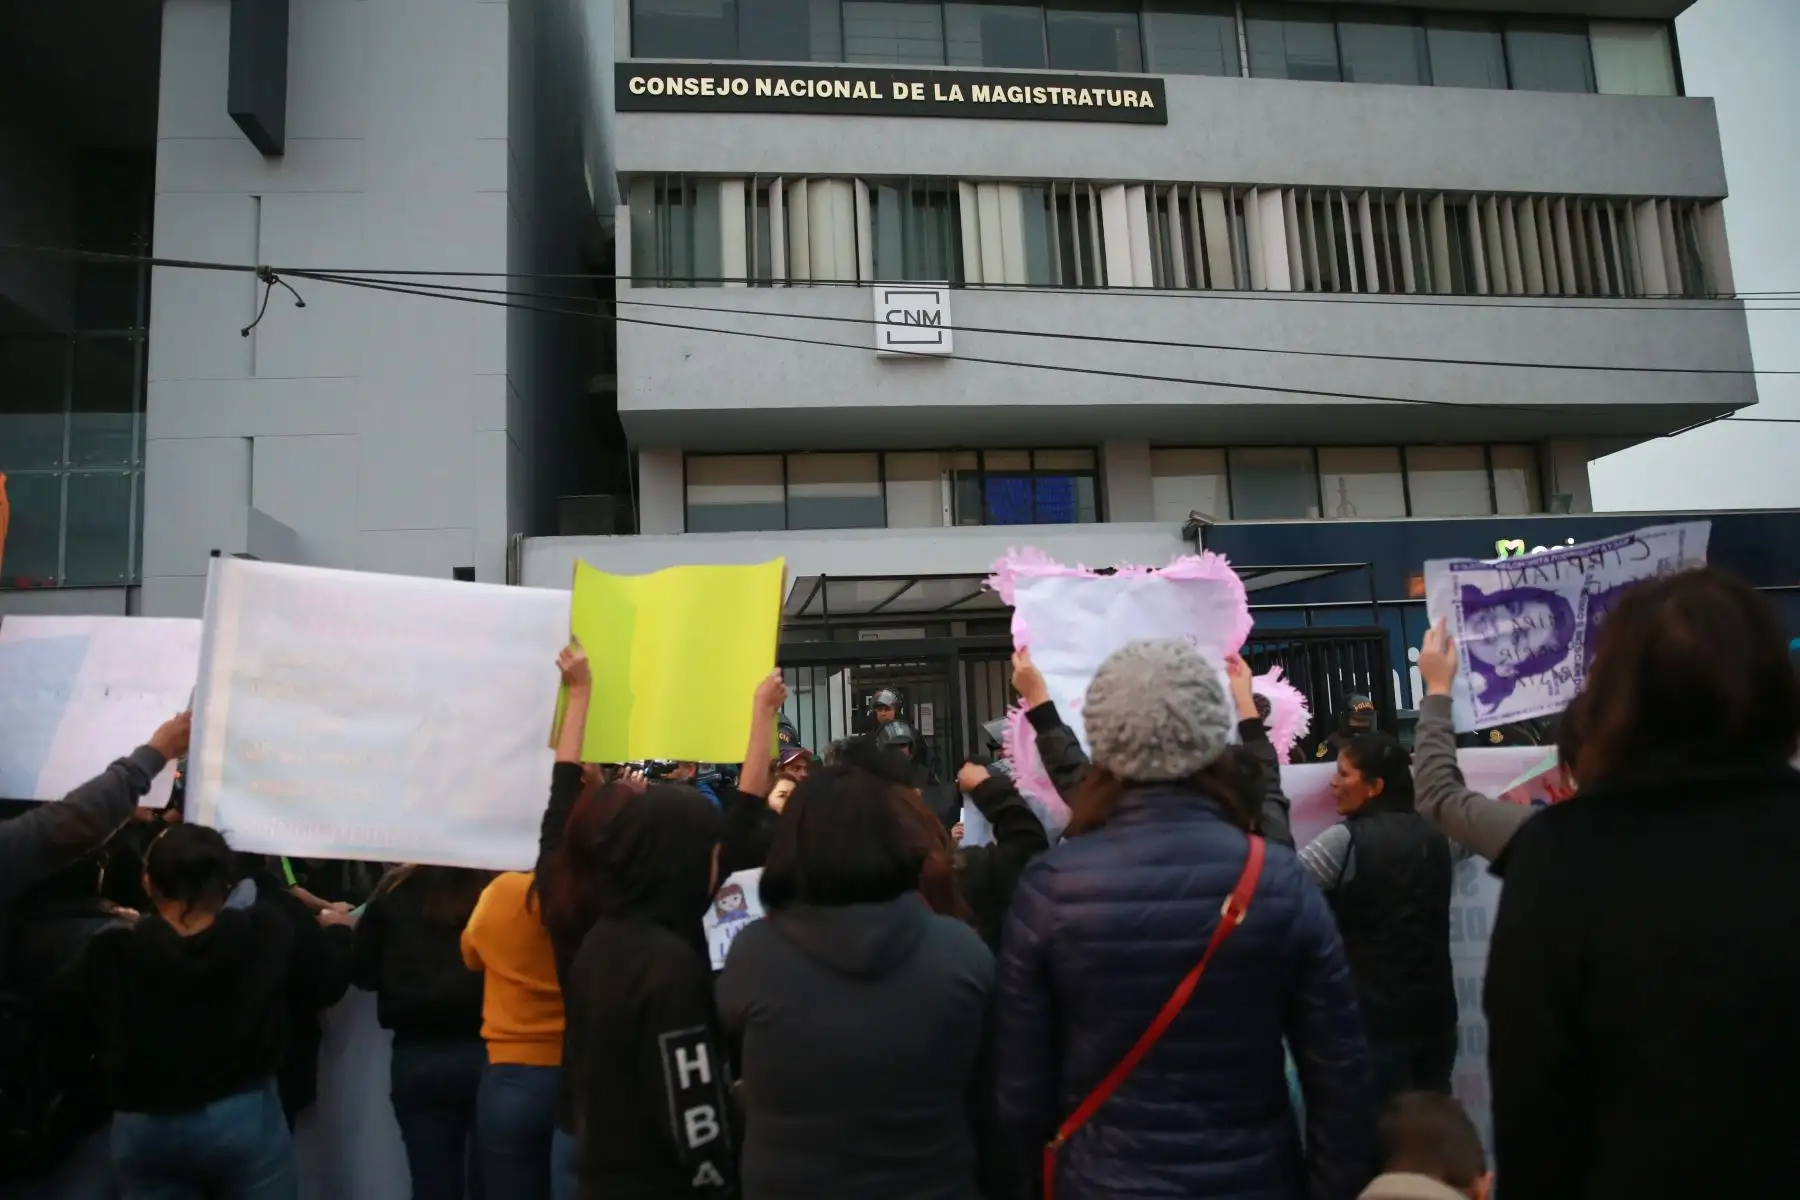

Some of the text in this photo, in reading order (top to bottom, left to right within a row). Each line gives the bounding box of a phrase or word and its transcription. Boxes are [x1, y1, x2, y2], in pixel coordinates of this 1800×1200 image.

[629, 76, 1155, 108] CONSEJO NACIONAL DE LA MAGISTRATURA
[885, 309, 942, 327] CNM
